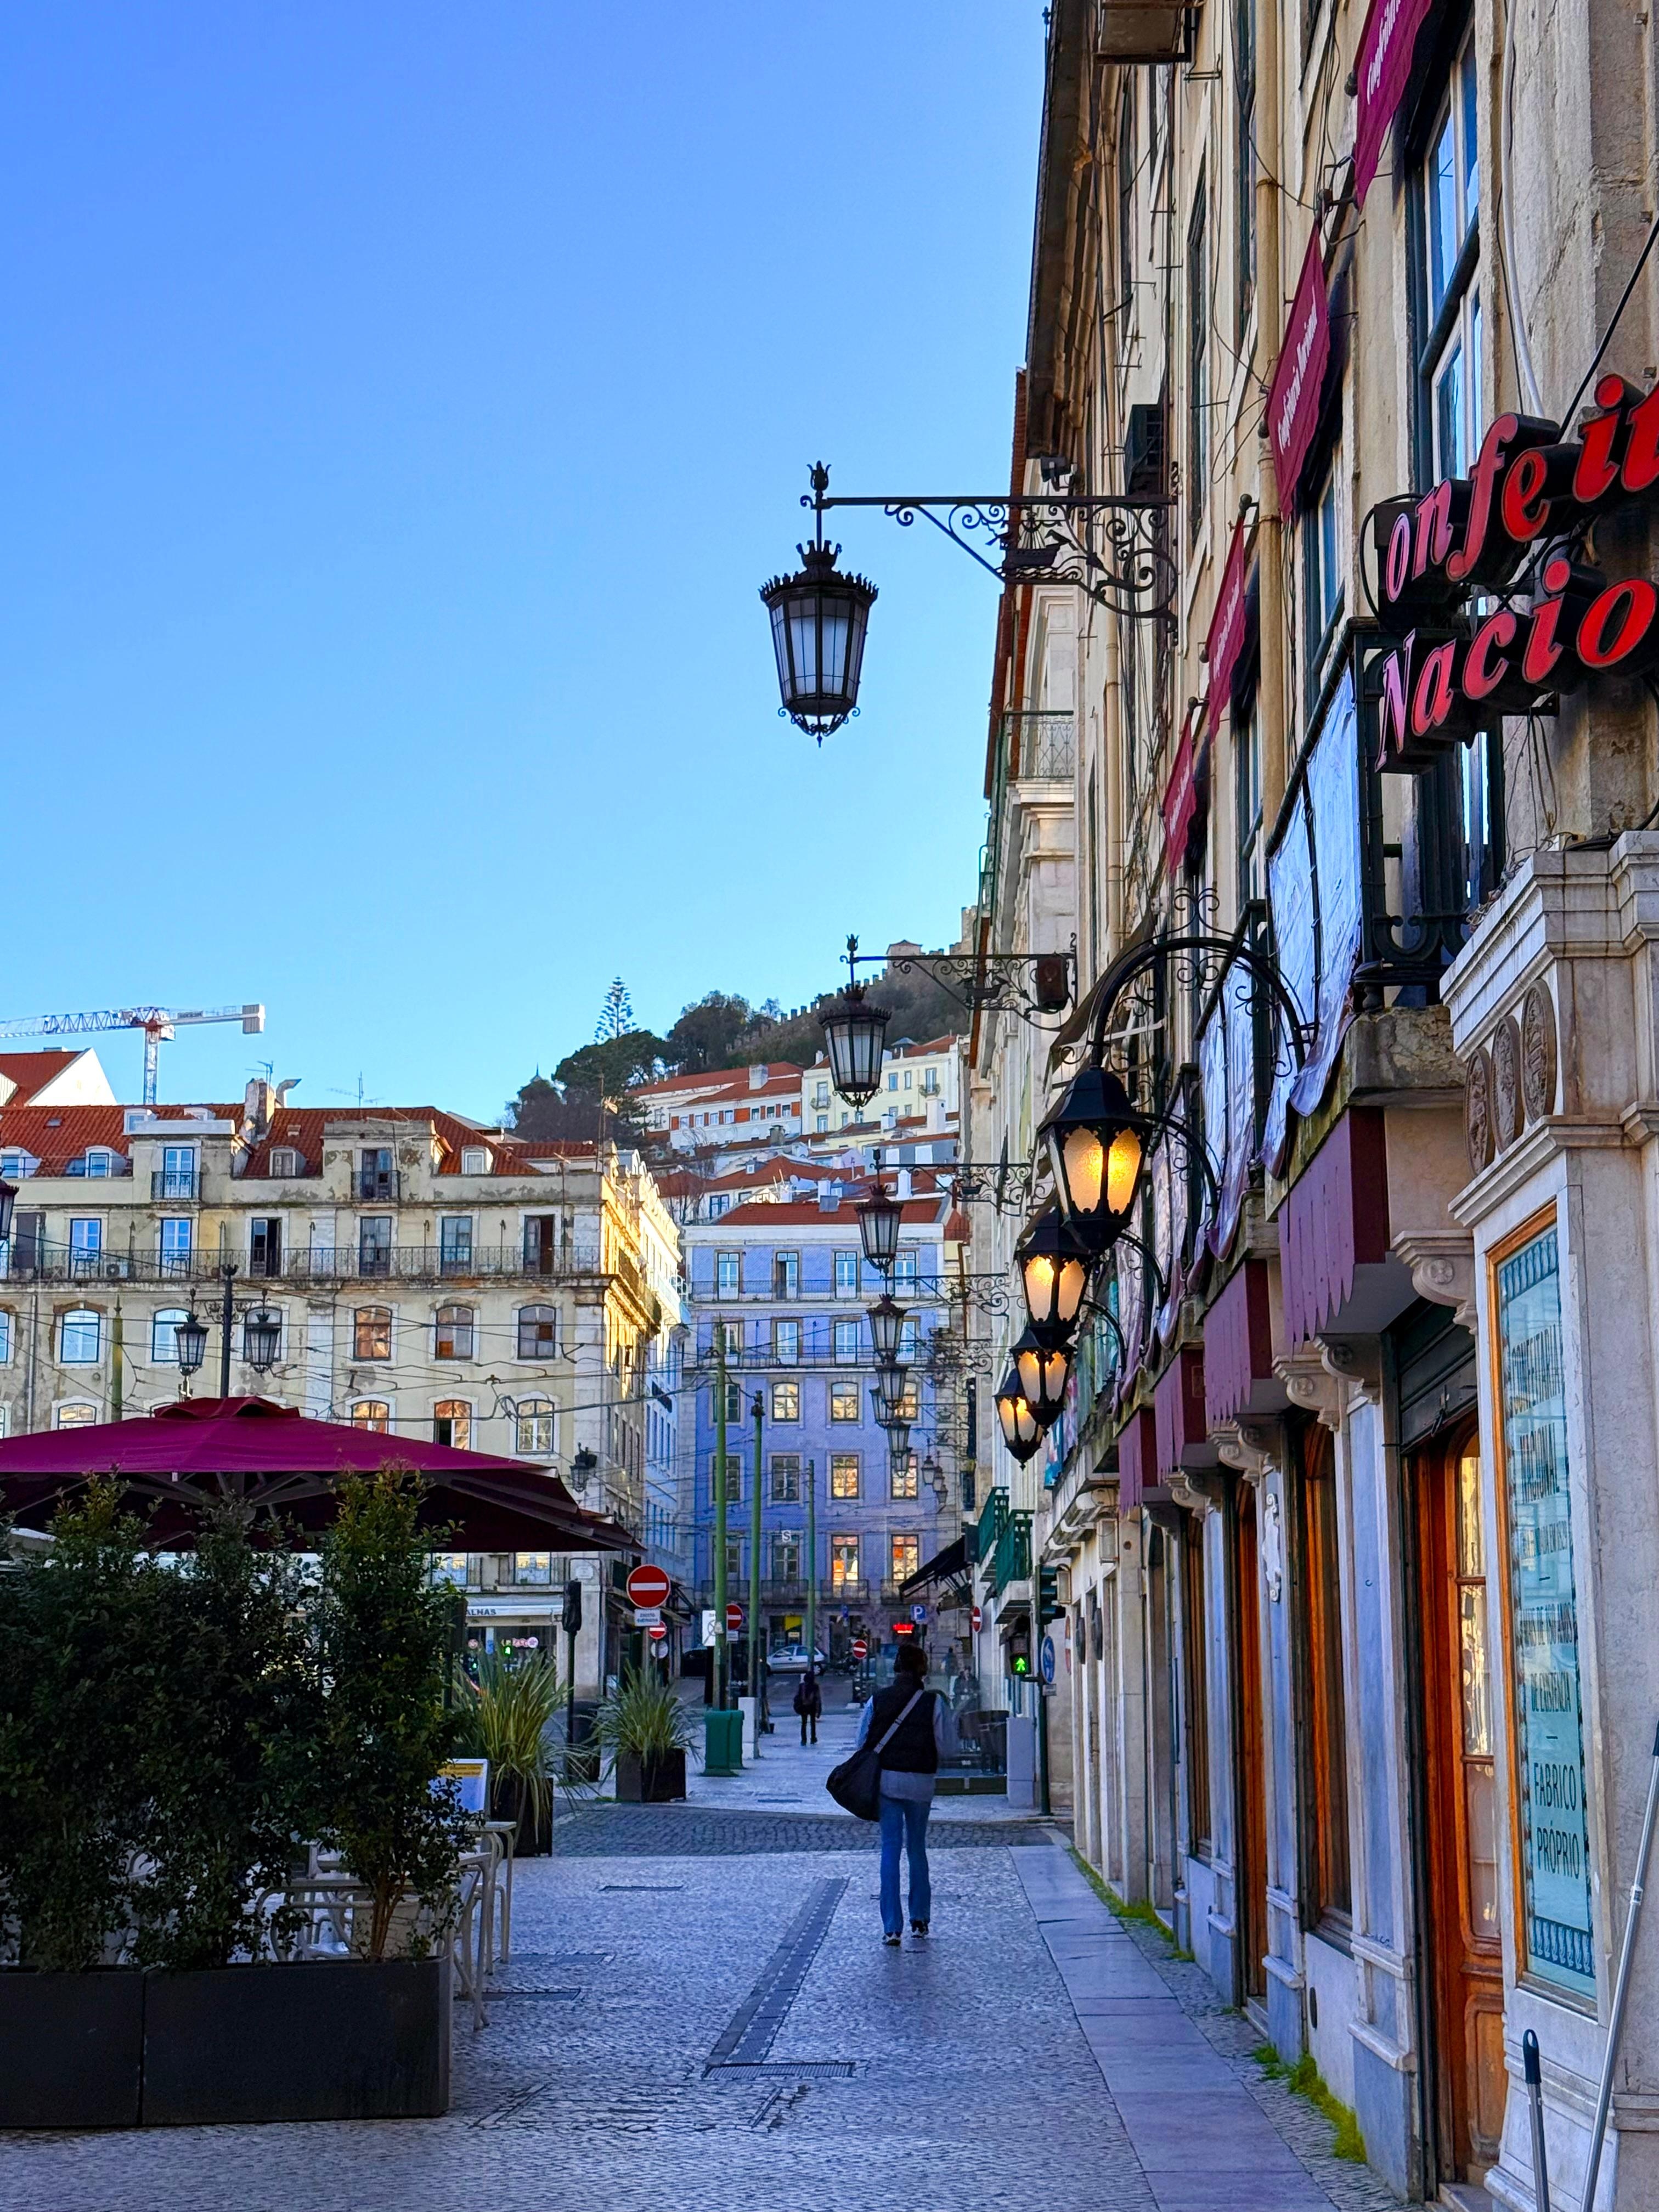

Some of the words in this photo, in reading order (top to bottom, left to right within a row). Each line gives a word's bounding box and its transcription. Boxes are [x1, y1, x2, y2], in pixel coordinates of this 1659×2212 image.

[1376, 558, 1658, 769] Nacio
[1520, 1422, 1560, 1505] NACIONAL
[914, 1606, 923, 1620] P
[1534, 1763, 1577, 1811] FABRICO
[1537, 1820, 1580, 1879] PRÓPRIO
